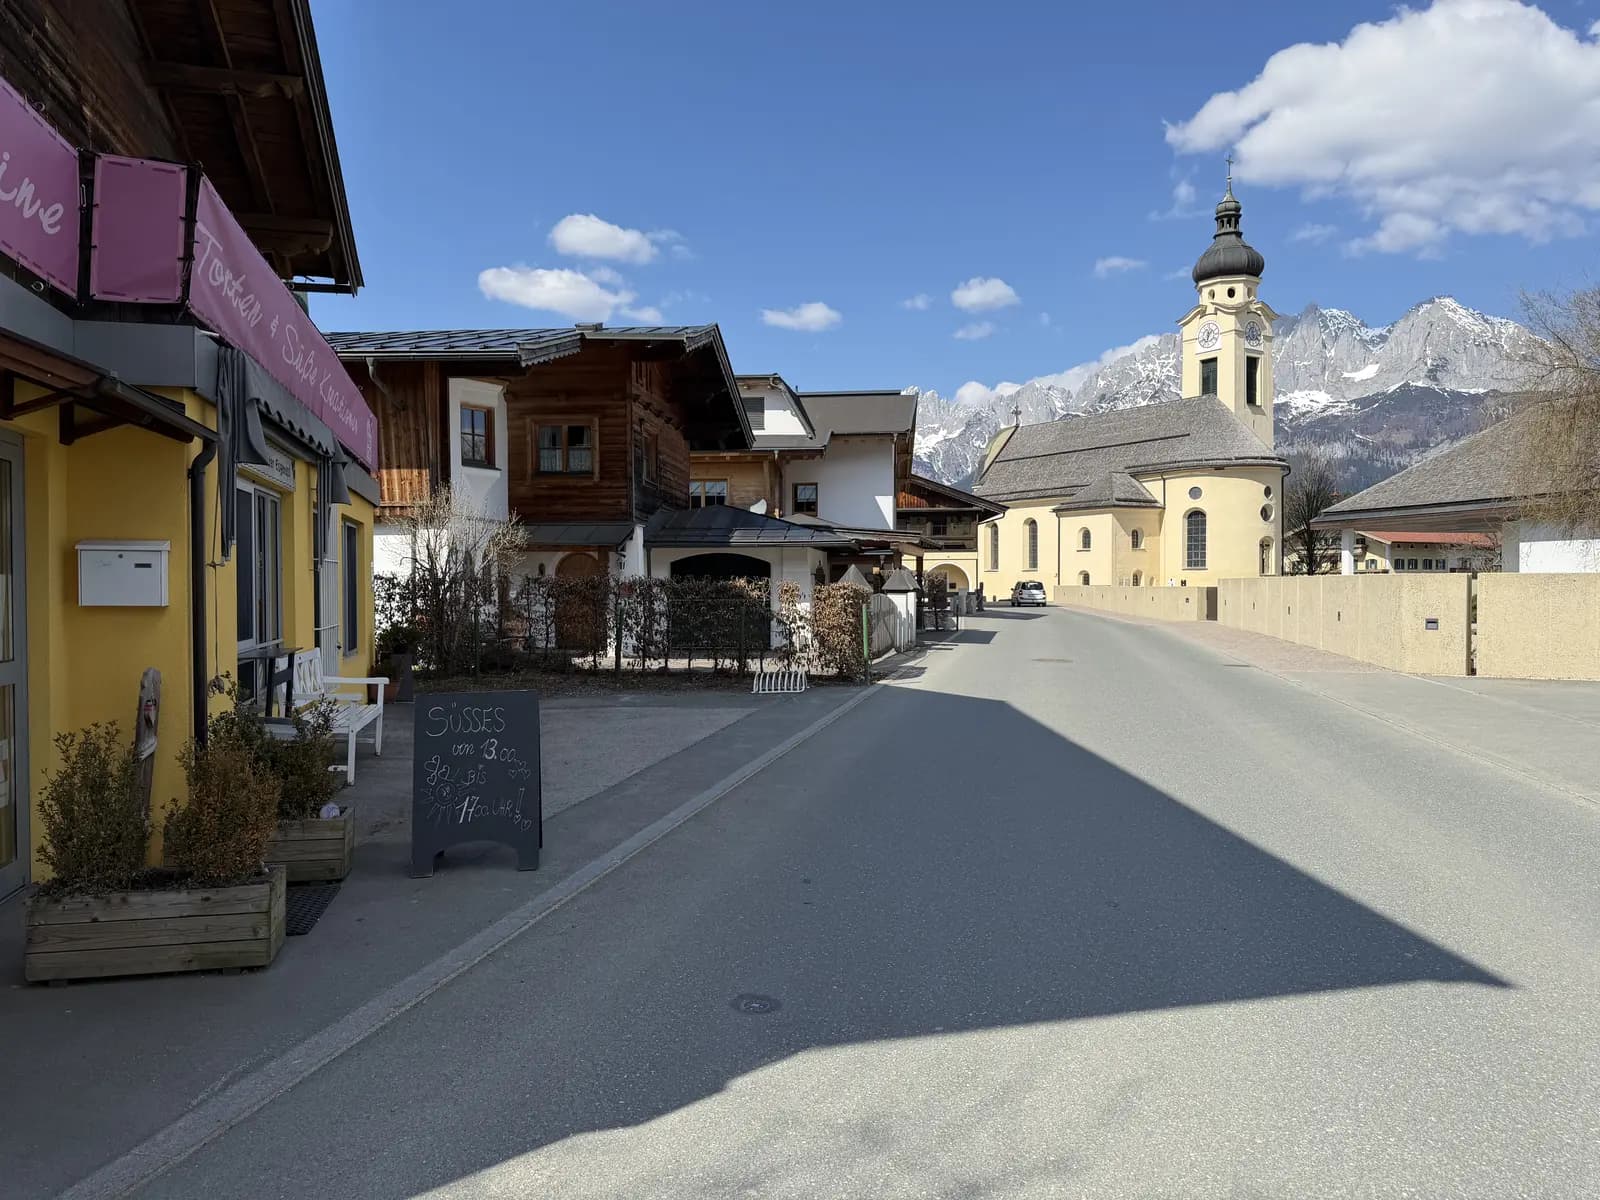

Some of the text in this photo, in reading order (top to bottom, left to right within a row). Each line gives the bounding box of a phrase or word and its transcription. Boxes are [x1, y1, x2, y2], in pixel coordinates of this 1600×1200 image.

[196, 221, 263, 328] Torten
[270, 314, 280, 339] &
[425, 702, 506, 737] SÜSSES
[452, 742, 475, 756] von
